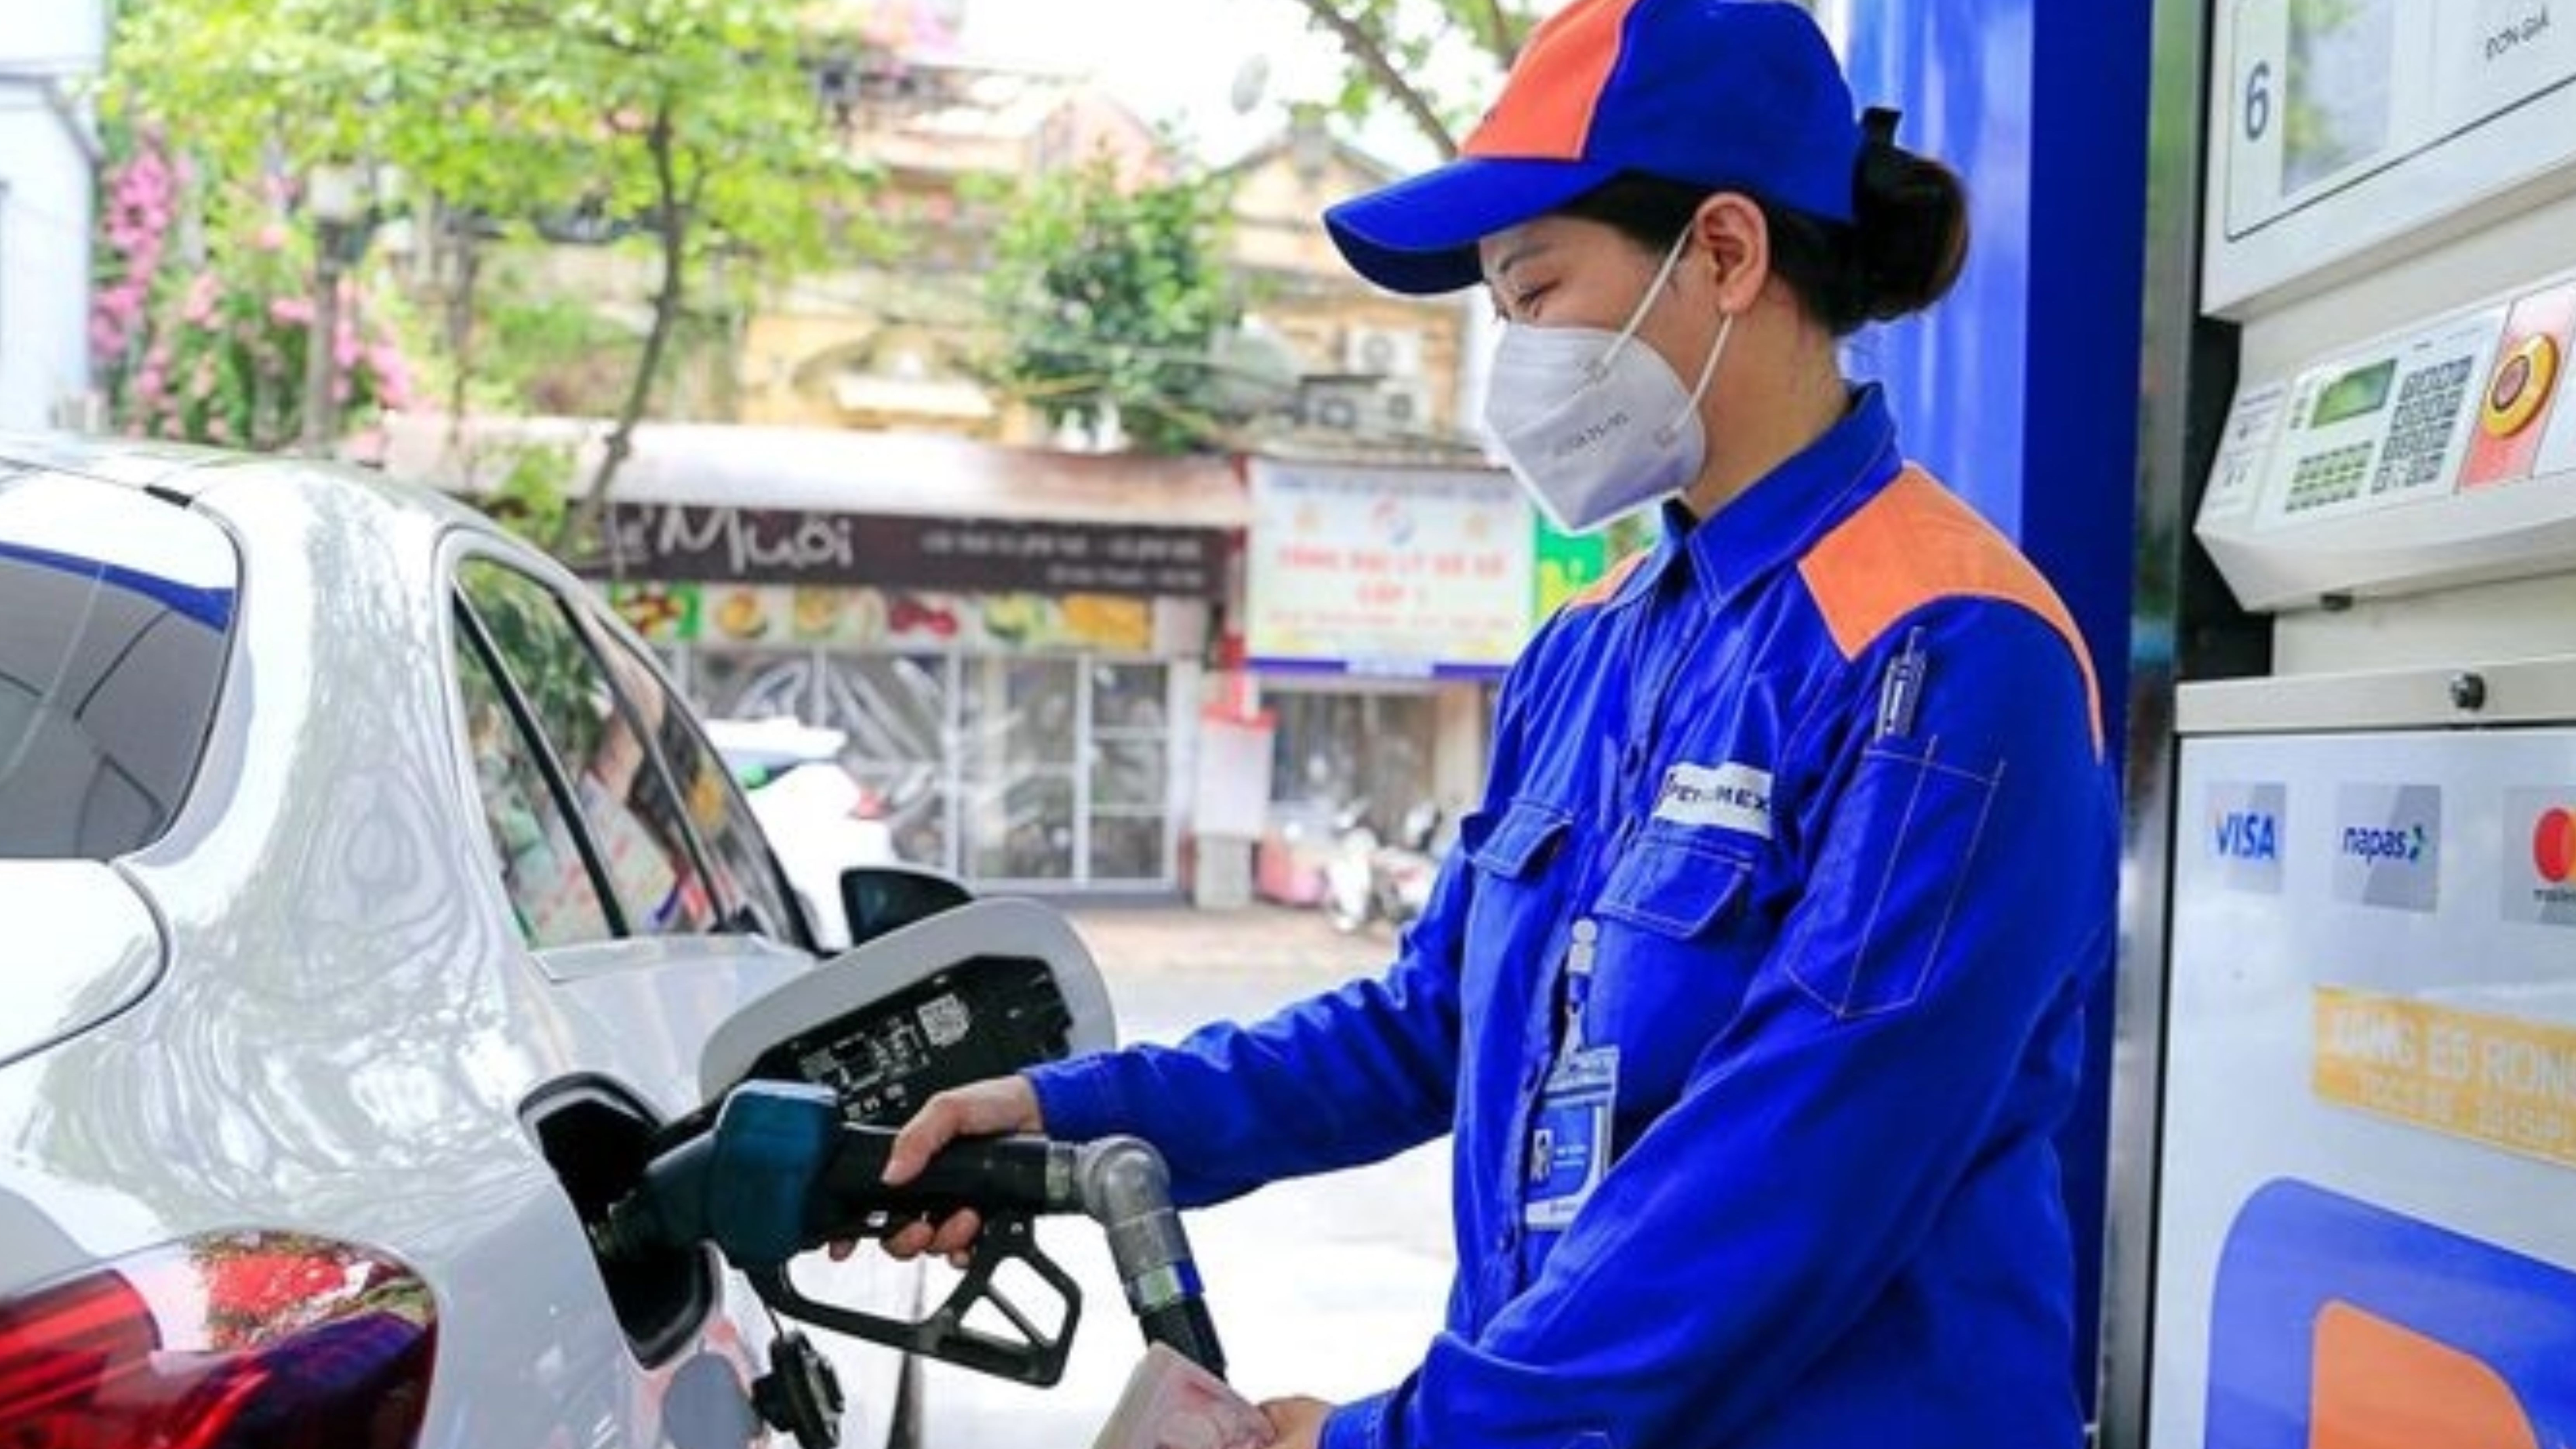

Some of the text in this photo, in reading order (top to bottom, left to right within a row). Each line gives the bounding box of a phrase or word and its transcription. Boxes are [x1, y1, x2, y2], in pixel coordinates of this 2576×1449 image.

[2246, 60, 2270, 140] 6
[2215, 812, 2276, 859] VISA
[2343, 824, 2407, 865] napas
